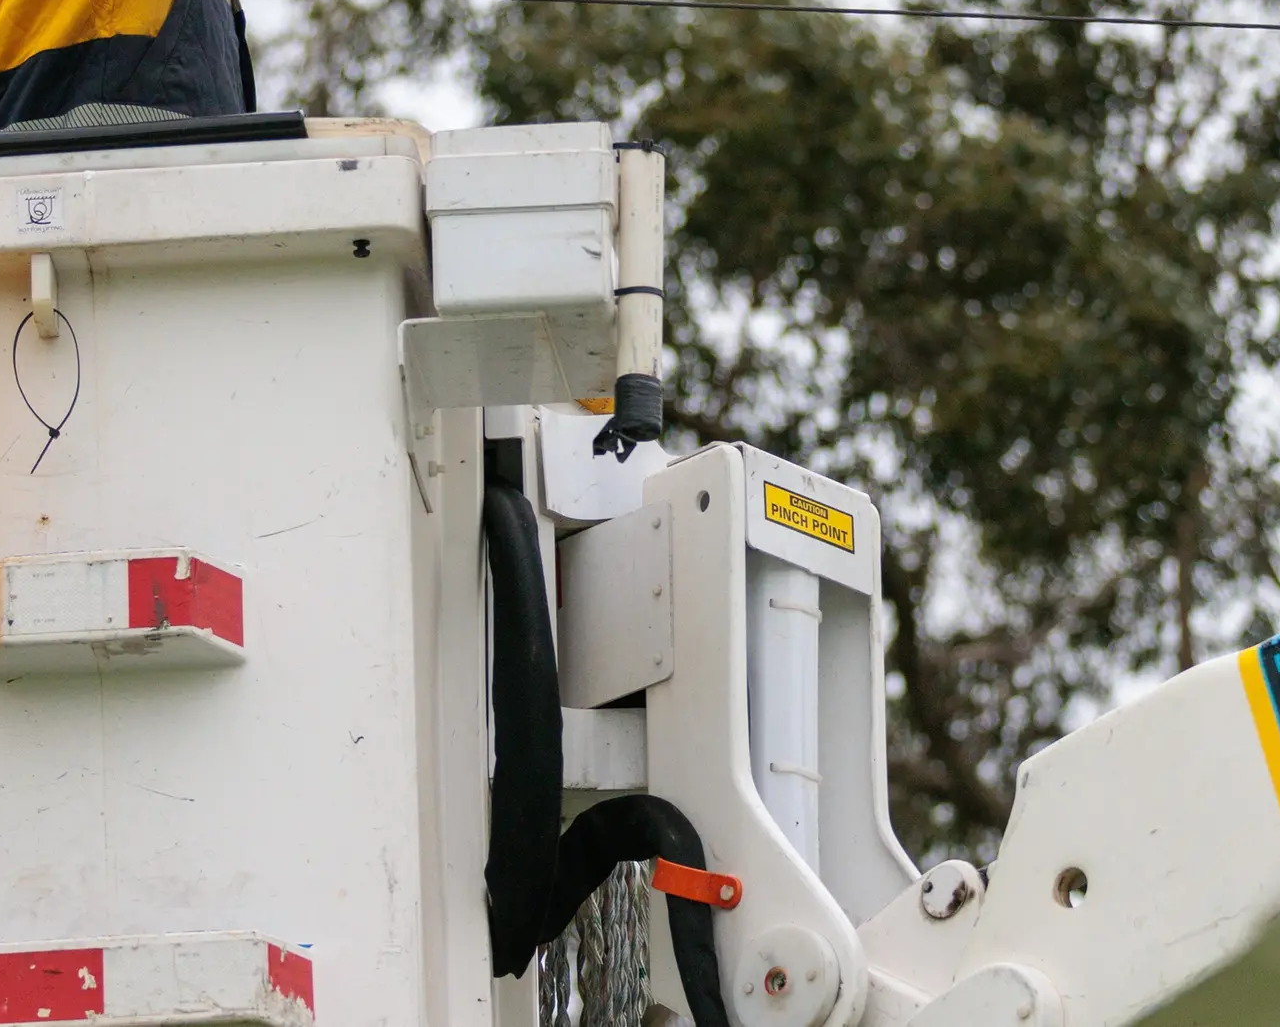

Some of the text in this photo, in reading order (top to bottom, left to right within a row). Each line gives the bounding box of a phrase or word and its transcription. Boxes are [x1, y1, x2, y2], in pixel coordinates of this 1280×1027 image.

[791, 497, 827, 518] CAUTION
[771, 503, 849, 544] PINCH POINT
